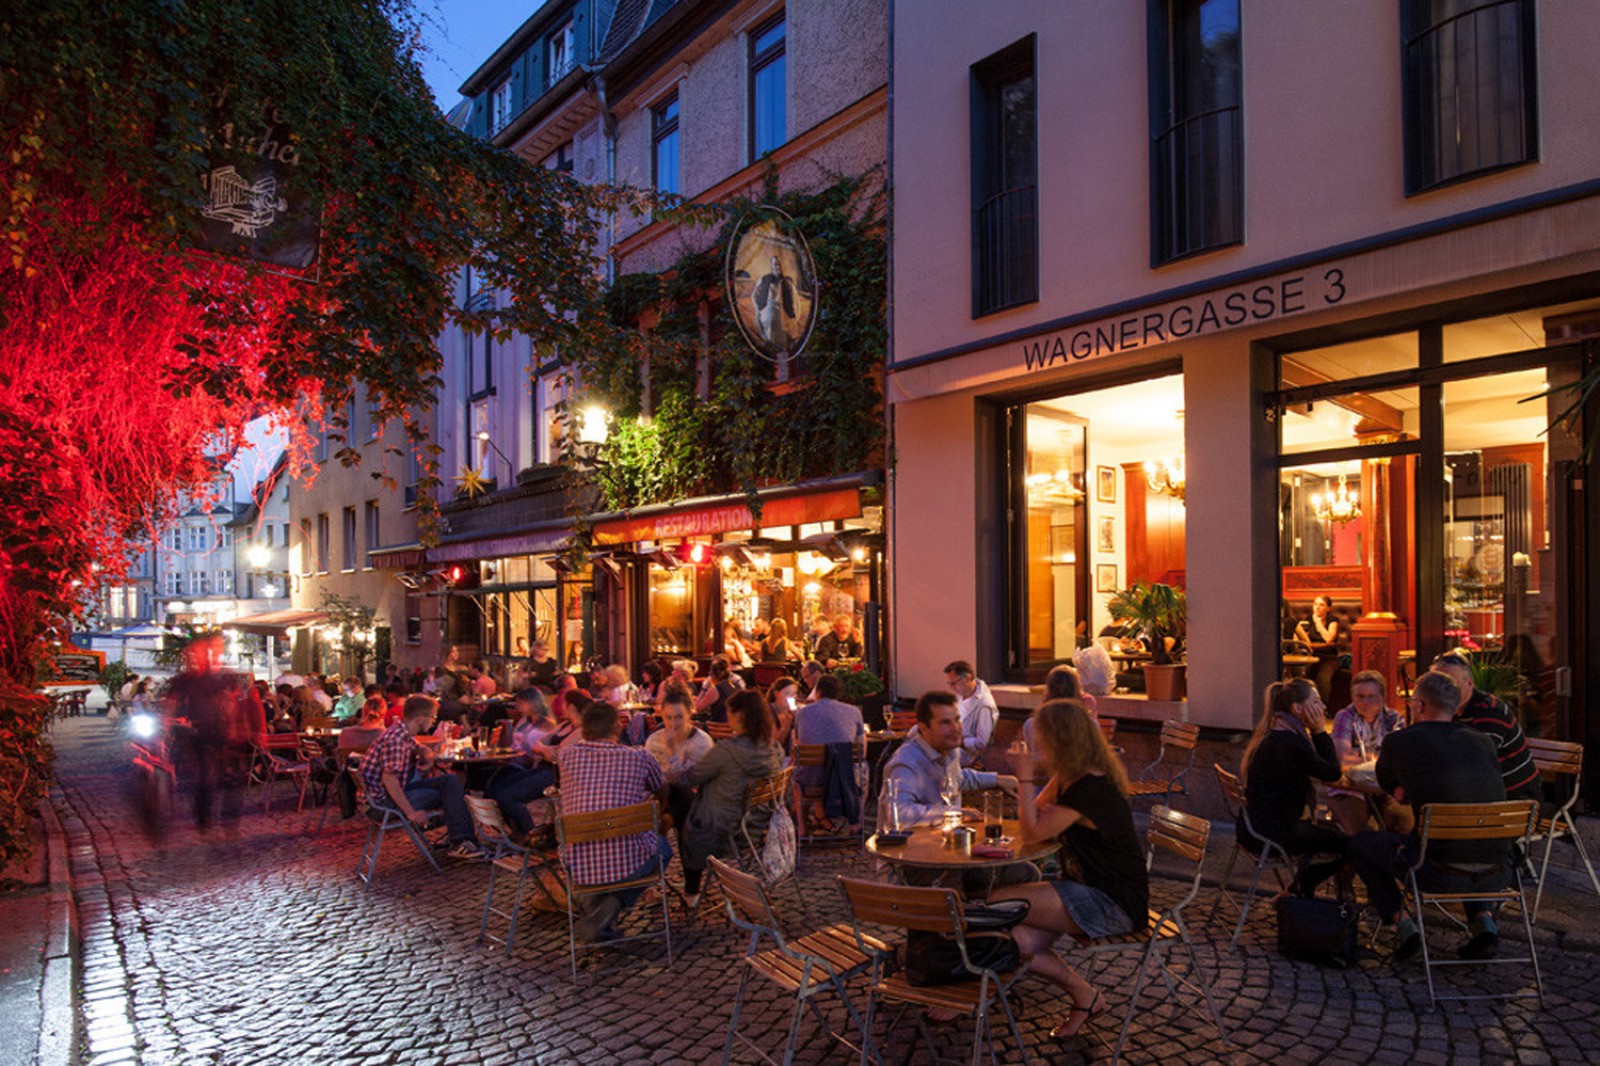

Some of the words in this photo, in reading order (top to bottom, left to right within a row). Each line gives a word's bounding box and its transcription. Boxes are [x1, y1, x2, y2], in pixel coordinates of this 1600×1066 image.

[1023, 277, 1306, 372] WAGNERGASSE
[1323, 268, 1347, 304] 3
[654, 507, 753, 538] RESTAURATION
